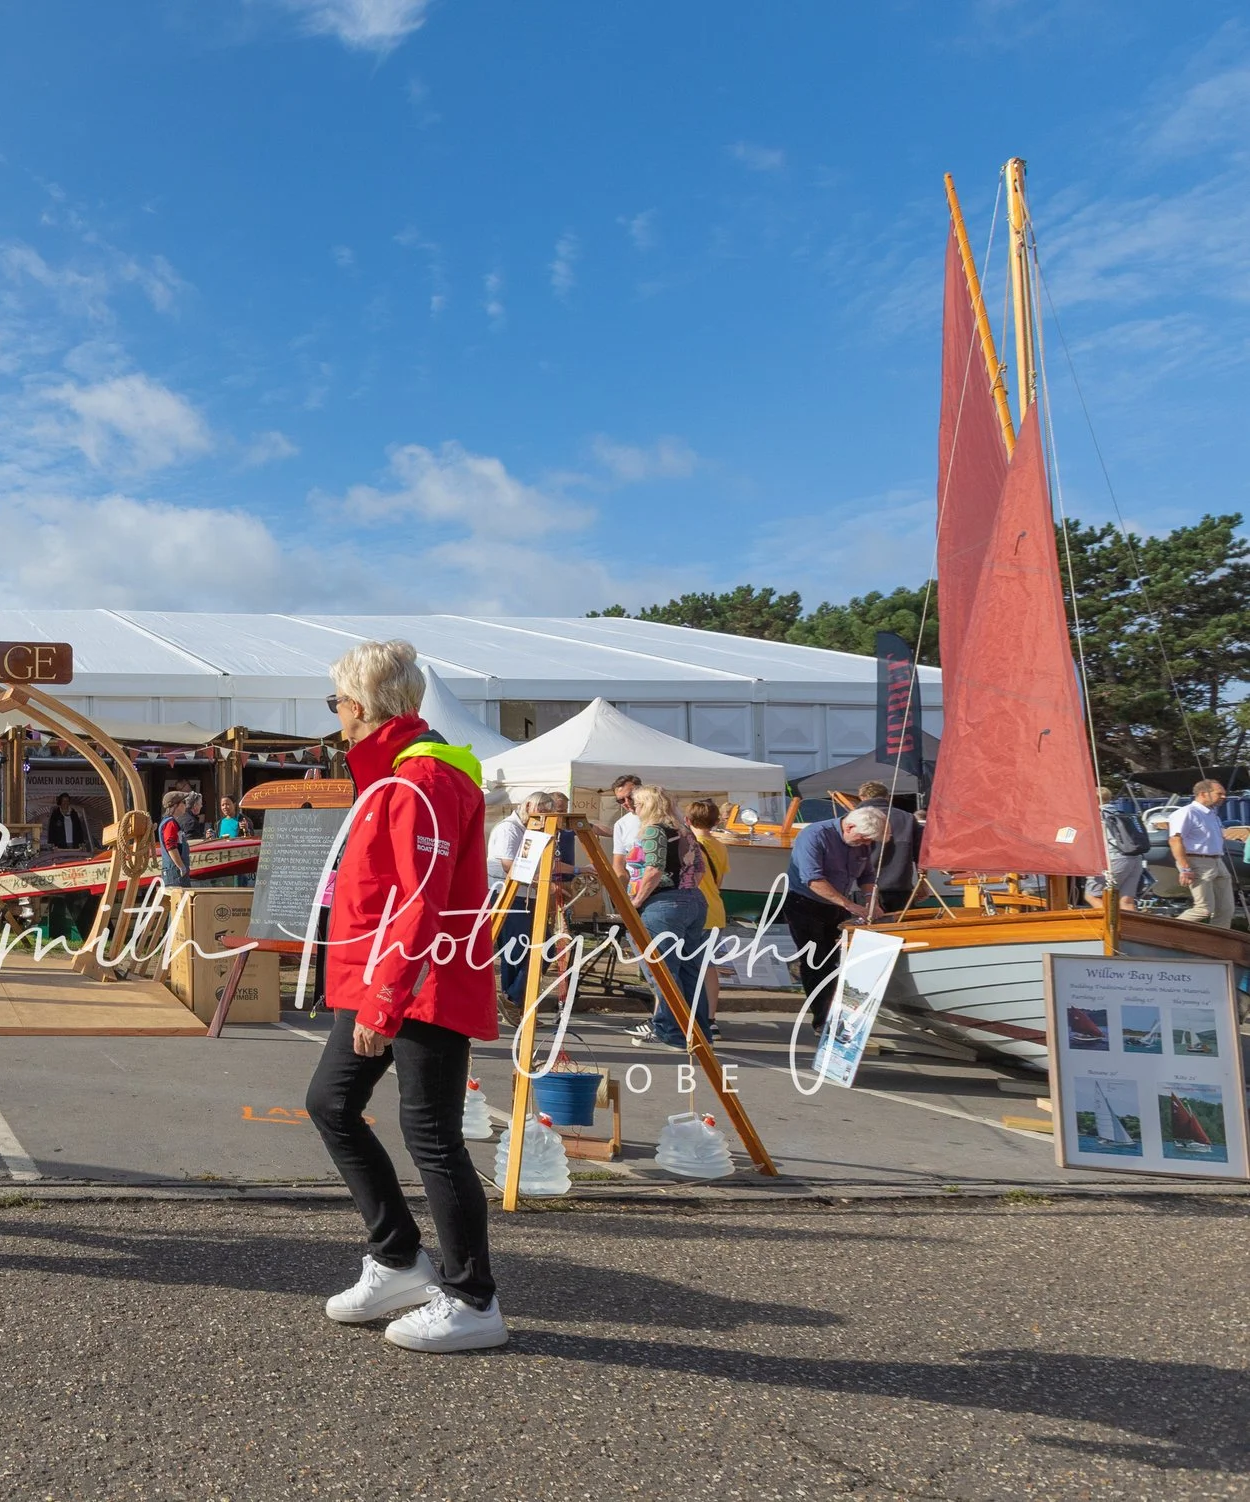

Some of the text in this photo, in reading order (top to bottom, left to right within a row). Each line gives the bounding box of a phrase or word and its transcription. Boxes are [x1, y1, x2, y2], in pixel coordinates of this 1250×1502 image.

[27, 776, 54, 786] WOMEN
[55, 776, 63, 786] IN
[65, 776, 84, 786] BOAT
[251, 784, 298, 800] WOODEN
[304, 783, 331, 793] BOAT
[417, 844, 433, 852] BOAT
[1085, 966, 1192, 985] Willow Bay Boats
